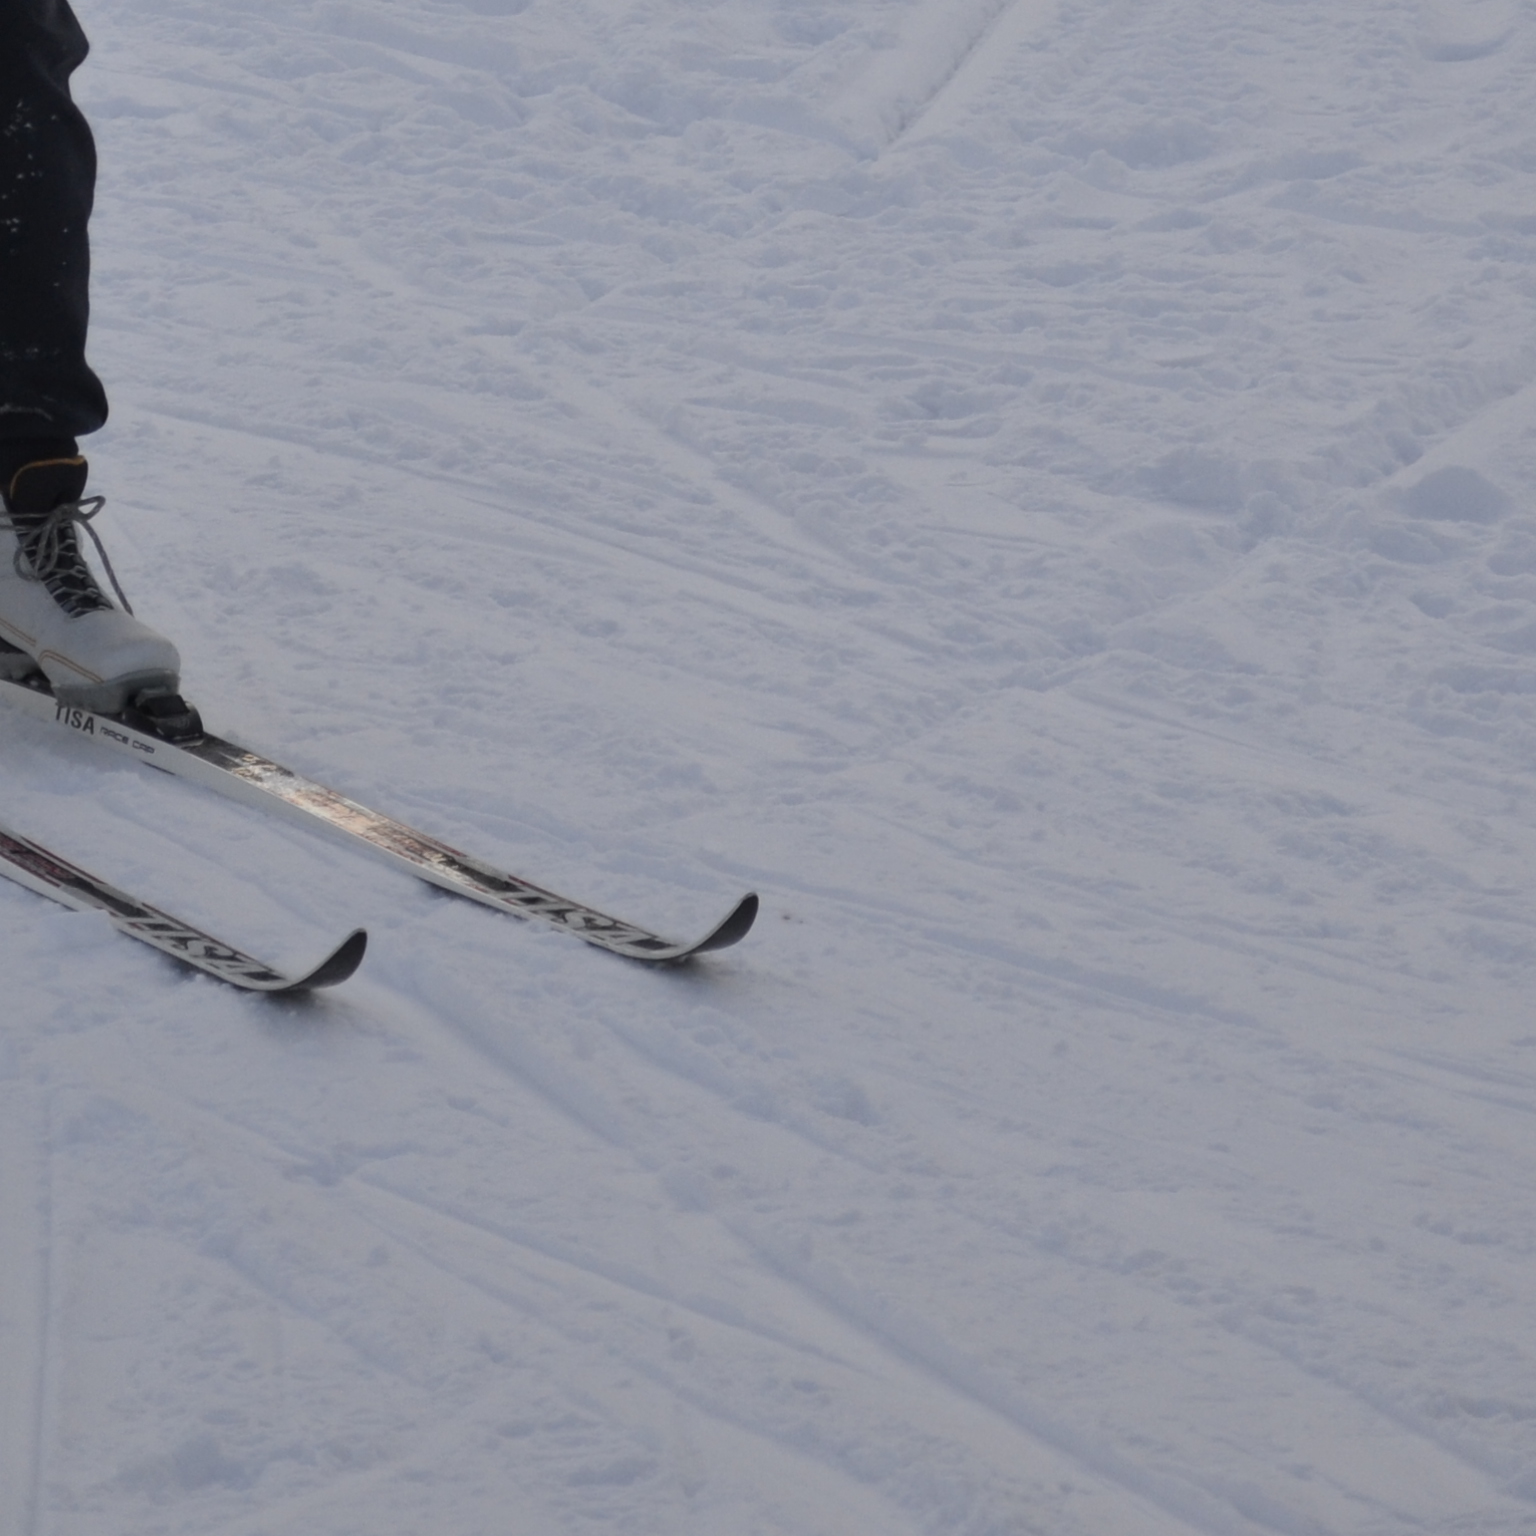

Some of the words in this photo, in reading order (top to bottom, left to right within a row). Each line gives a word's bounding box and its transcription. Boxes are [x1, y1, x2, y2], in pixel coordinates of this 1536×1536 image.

[56, 702, 94, 735] TISA
[100, 726, 129, 745] RACE
[132, 740, 155, 754] CAP
